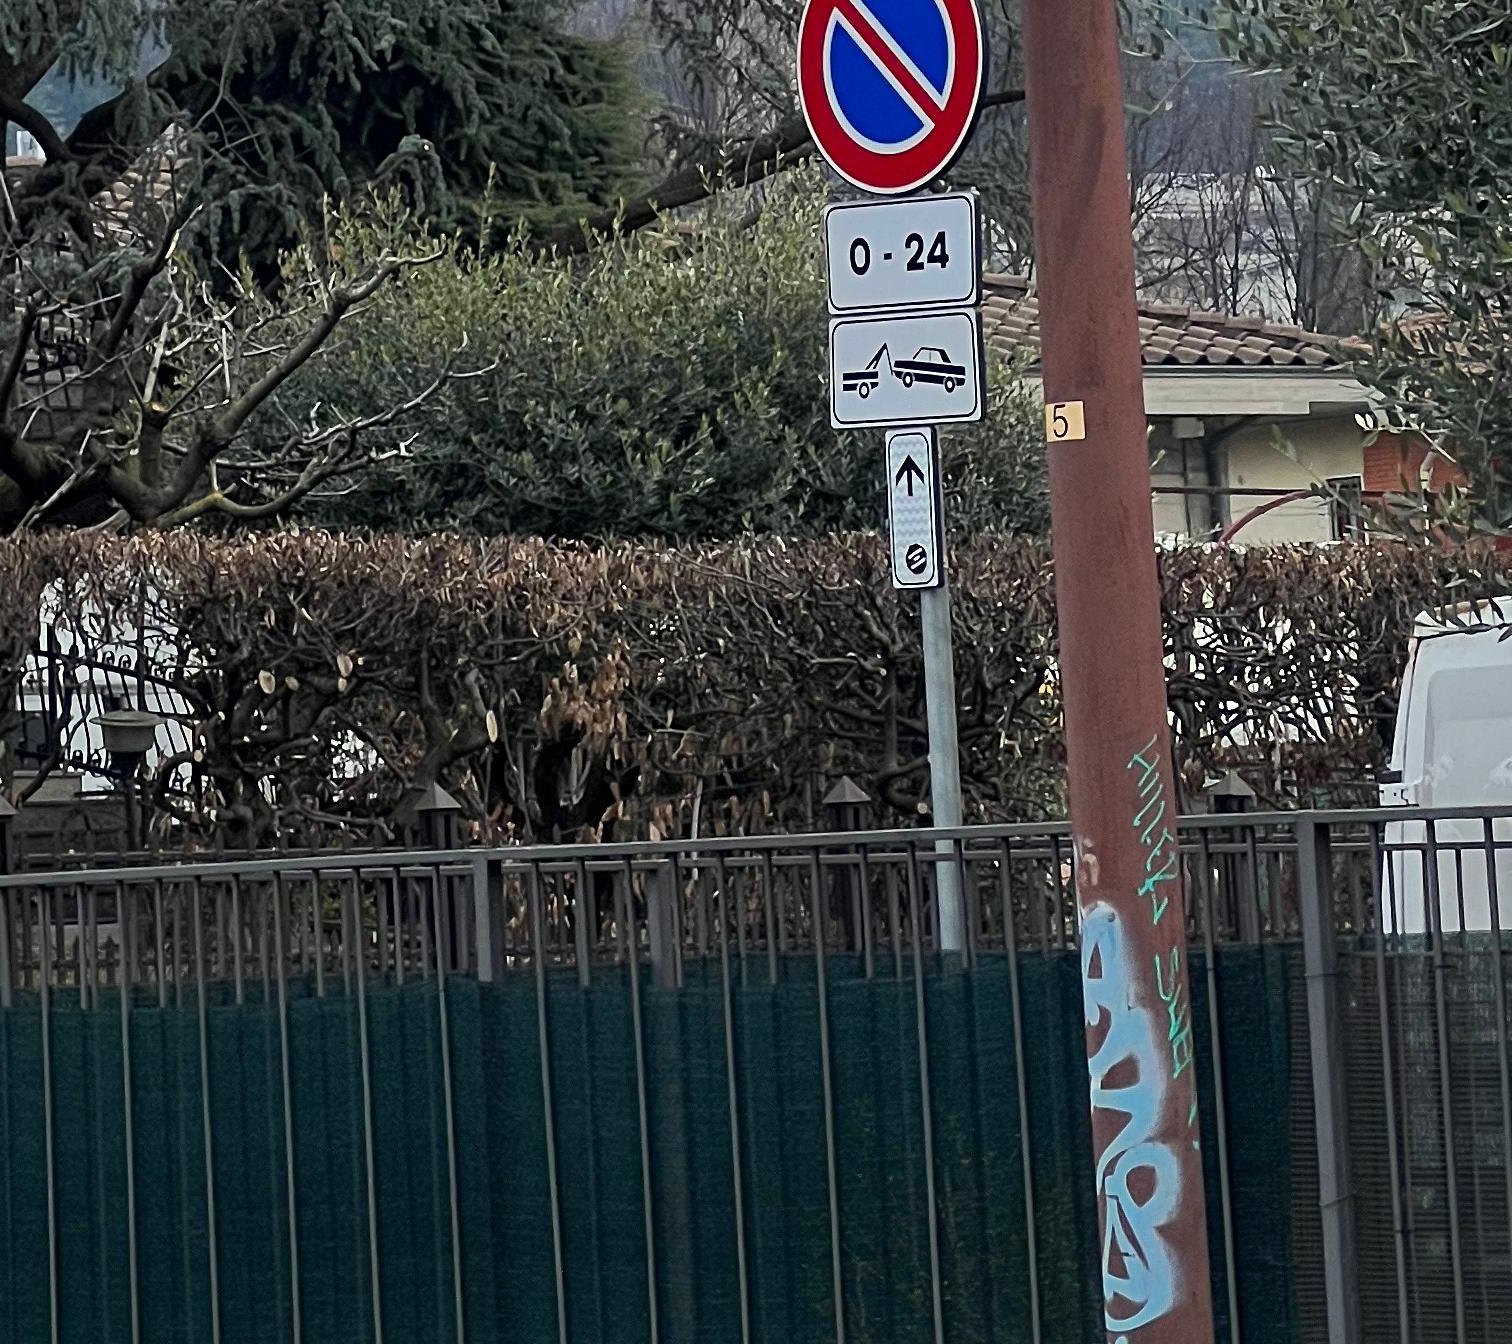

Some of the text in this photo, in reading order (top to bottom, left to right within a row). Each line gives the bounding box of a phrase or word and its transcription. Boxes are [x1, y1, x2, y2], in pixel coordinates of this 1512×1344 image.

[850, 231, 949, 275] 0 - 24
[1053, 404, 1068, 438] 5
